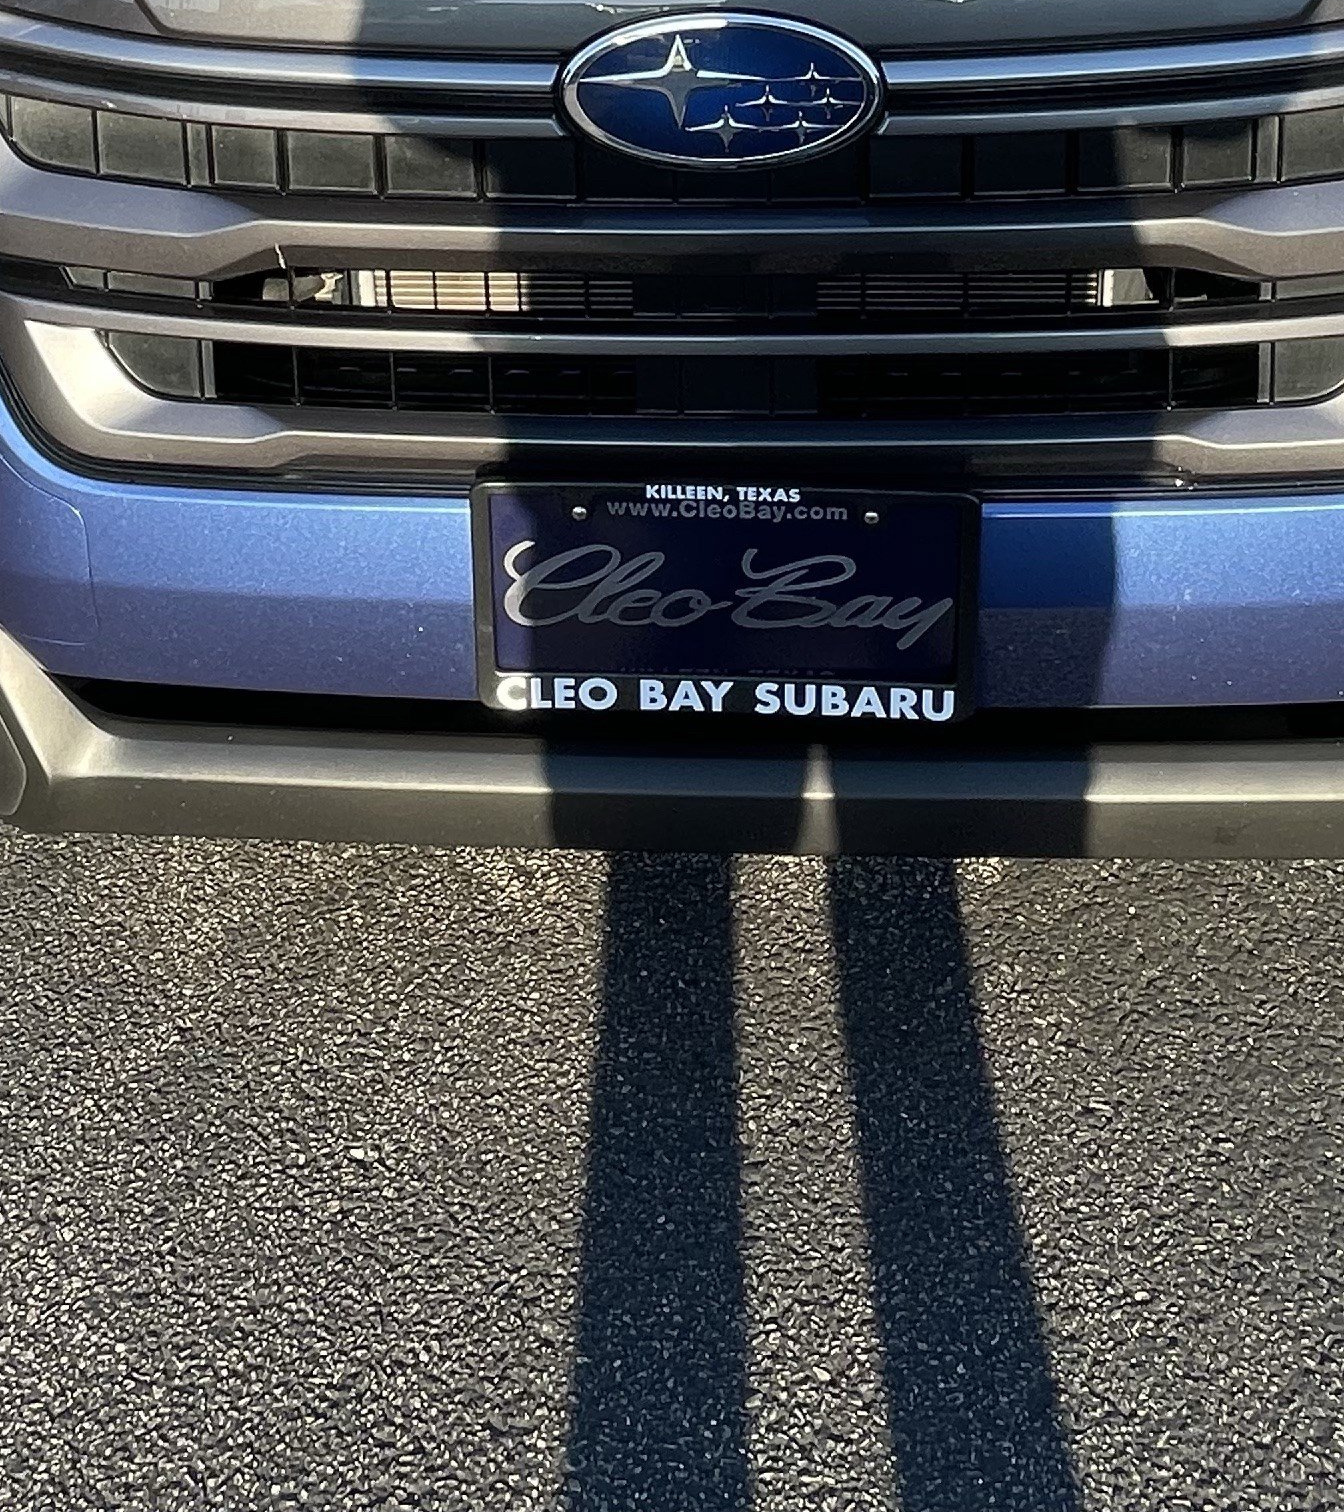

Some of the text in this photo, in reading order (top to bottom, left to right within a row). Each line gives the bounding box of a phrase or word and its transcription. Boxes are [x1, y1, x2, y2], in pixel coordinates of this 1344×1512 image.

[646, 484, 801, 503] KILLEEN, TEXAS
[606, 500, 848, 523] www.CleoBay.com
[504, 540, 954, 650] Cleo Bay
[496, 676, 955, 722] CLEO BAY SUBARU
